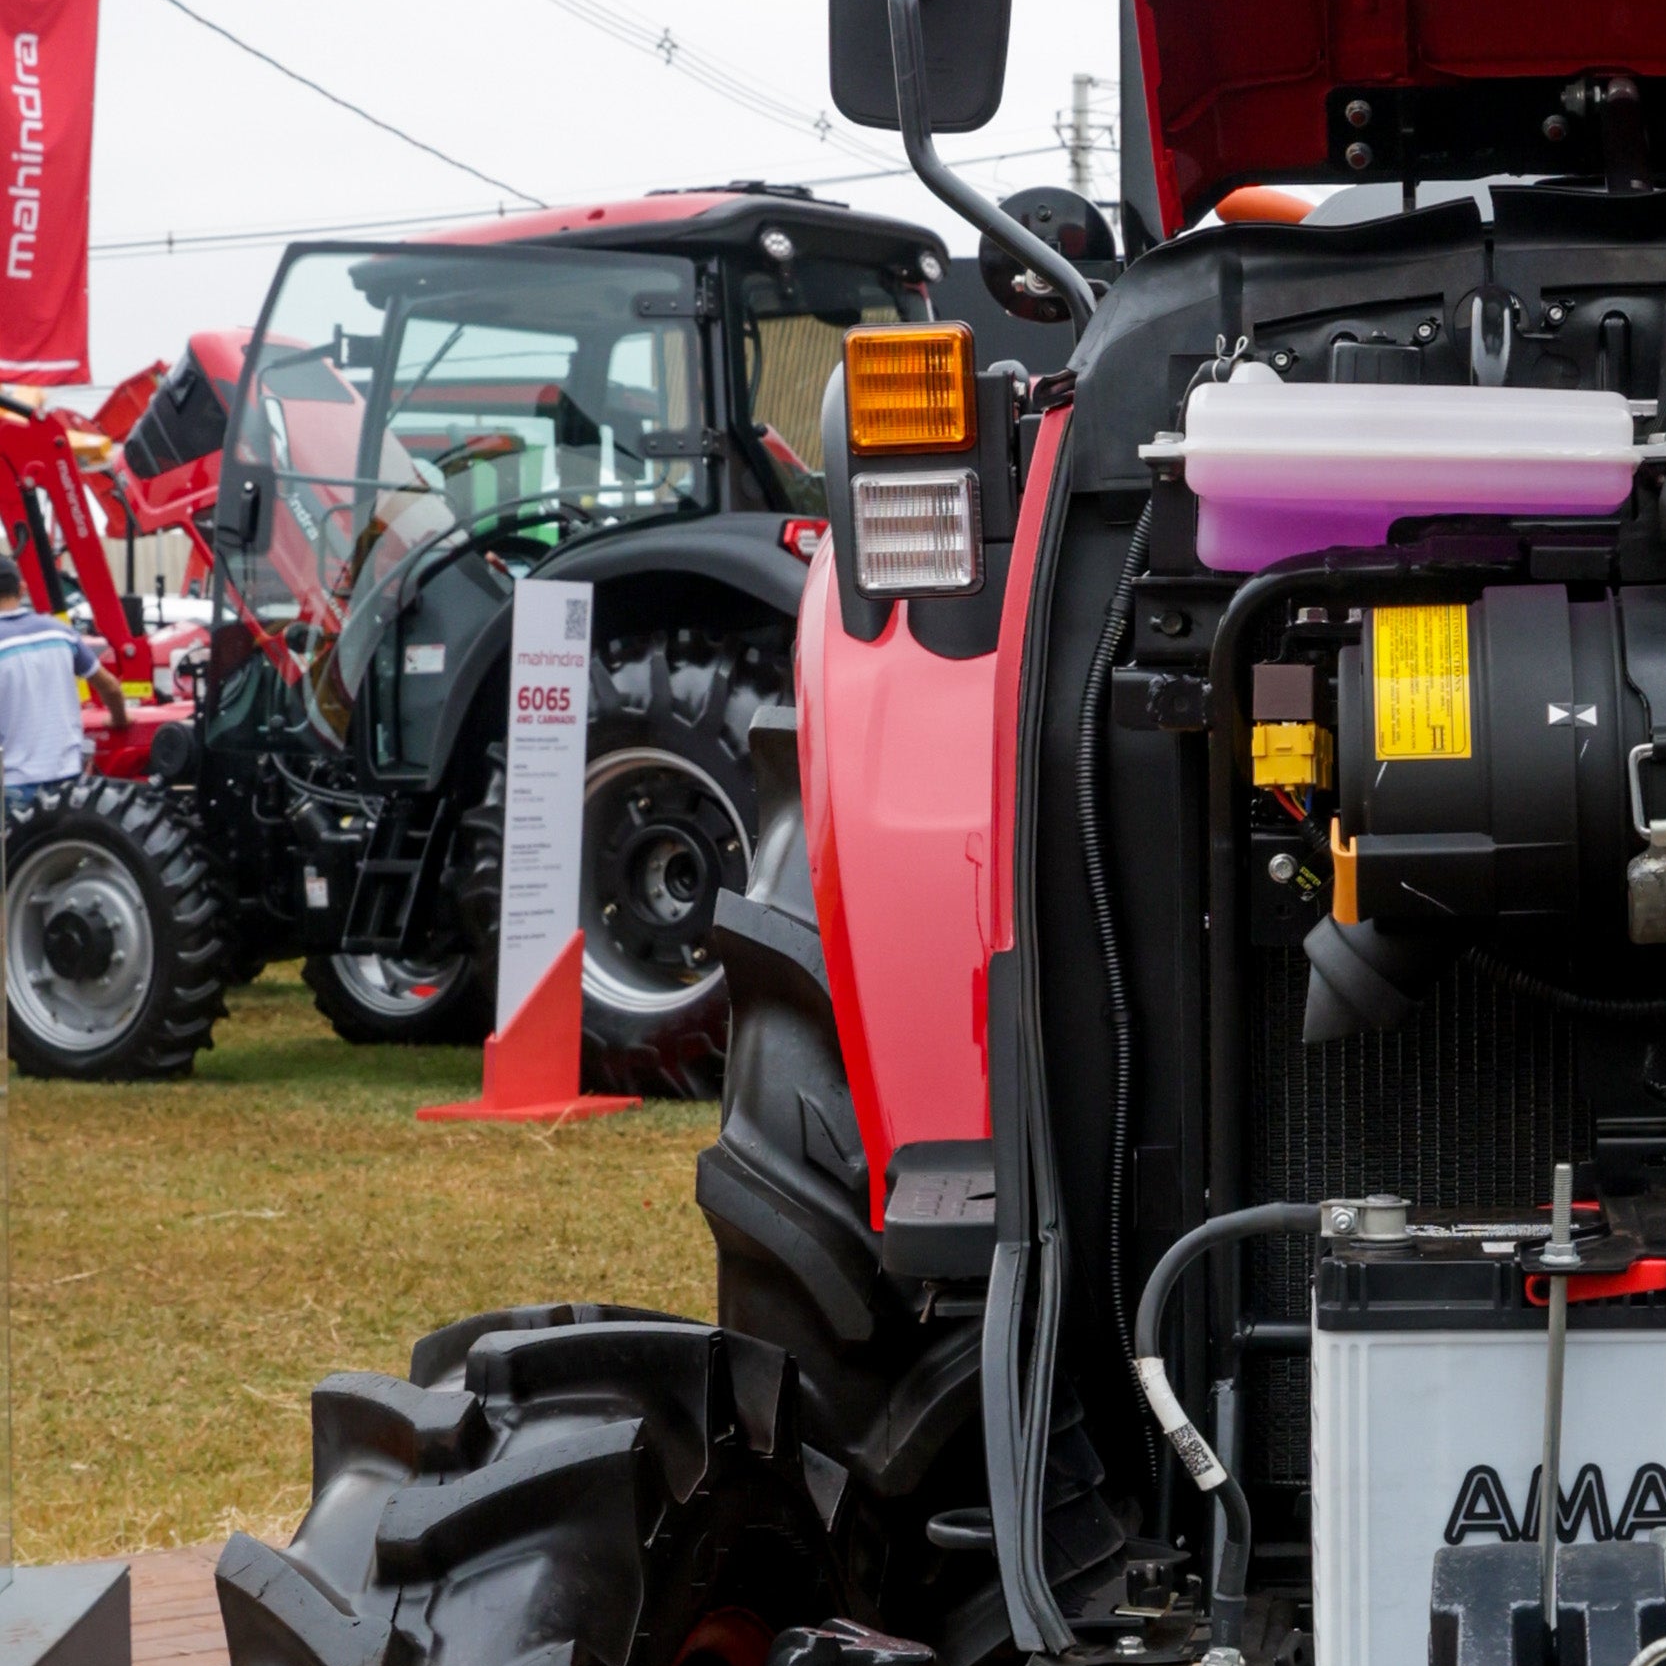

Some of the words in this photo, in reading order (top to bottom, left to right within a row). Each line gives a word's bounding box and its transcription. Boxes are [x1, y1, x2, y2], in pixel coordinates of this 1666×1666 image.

[7, 32, 43, 279] mahindra
[518, 650, 584, 668] mahindra
[517, 685, 570, 712] 6065
